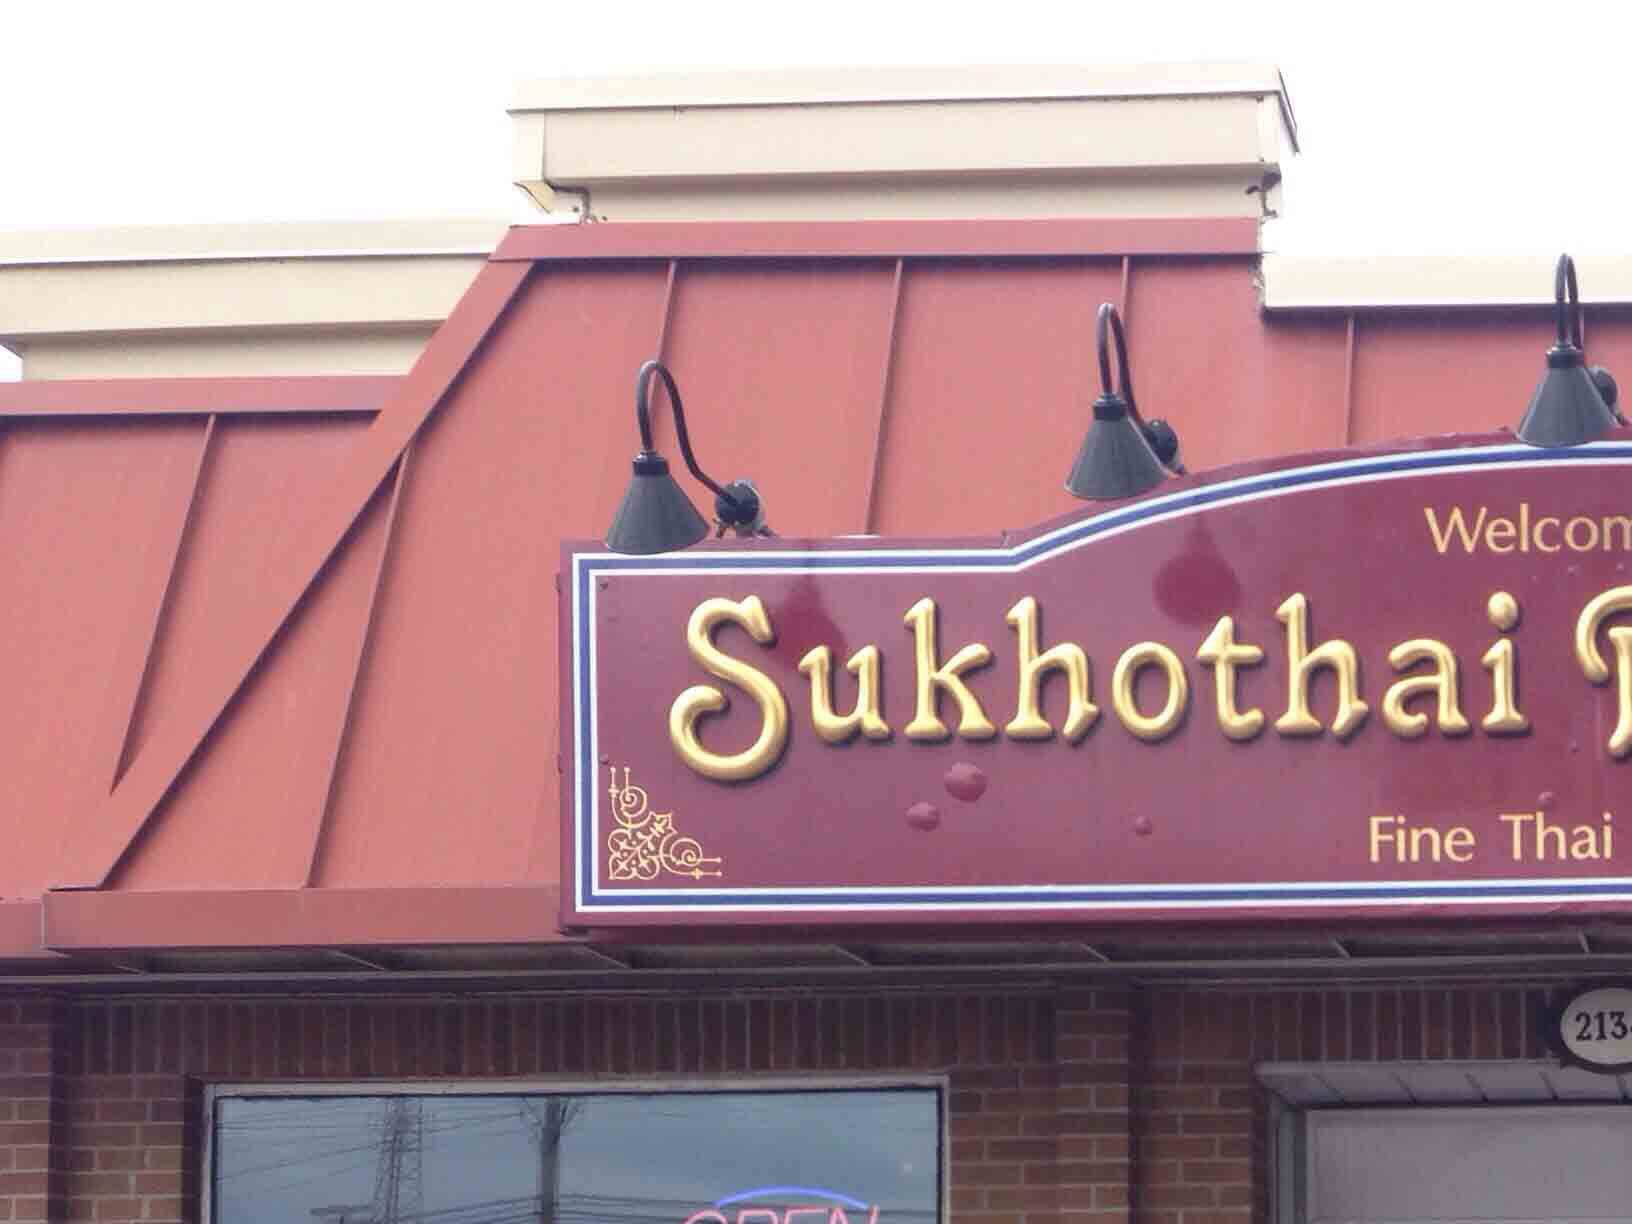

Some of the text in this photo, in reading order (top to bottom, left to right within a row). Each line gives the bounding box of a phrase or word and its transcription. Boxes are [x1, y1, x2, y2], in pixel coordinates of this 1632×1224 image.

[669, 592, 1531, 782] Sukhothai
[1369, 815, 1475, 863] Fine
[1499, 811, 1613, 861] Thai
